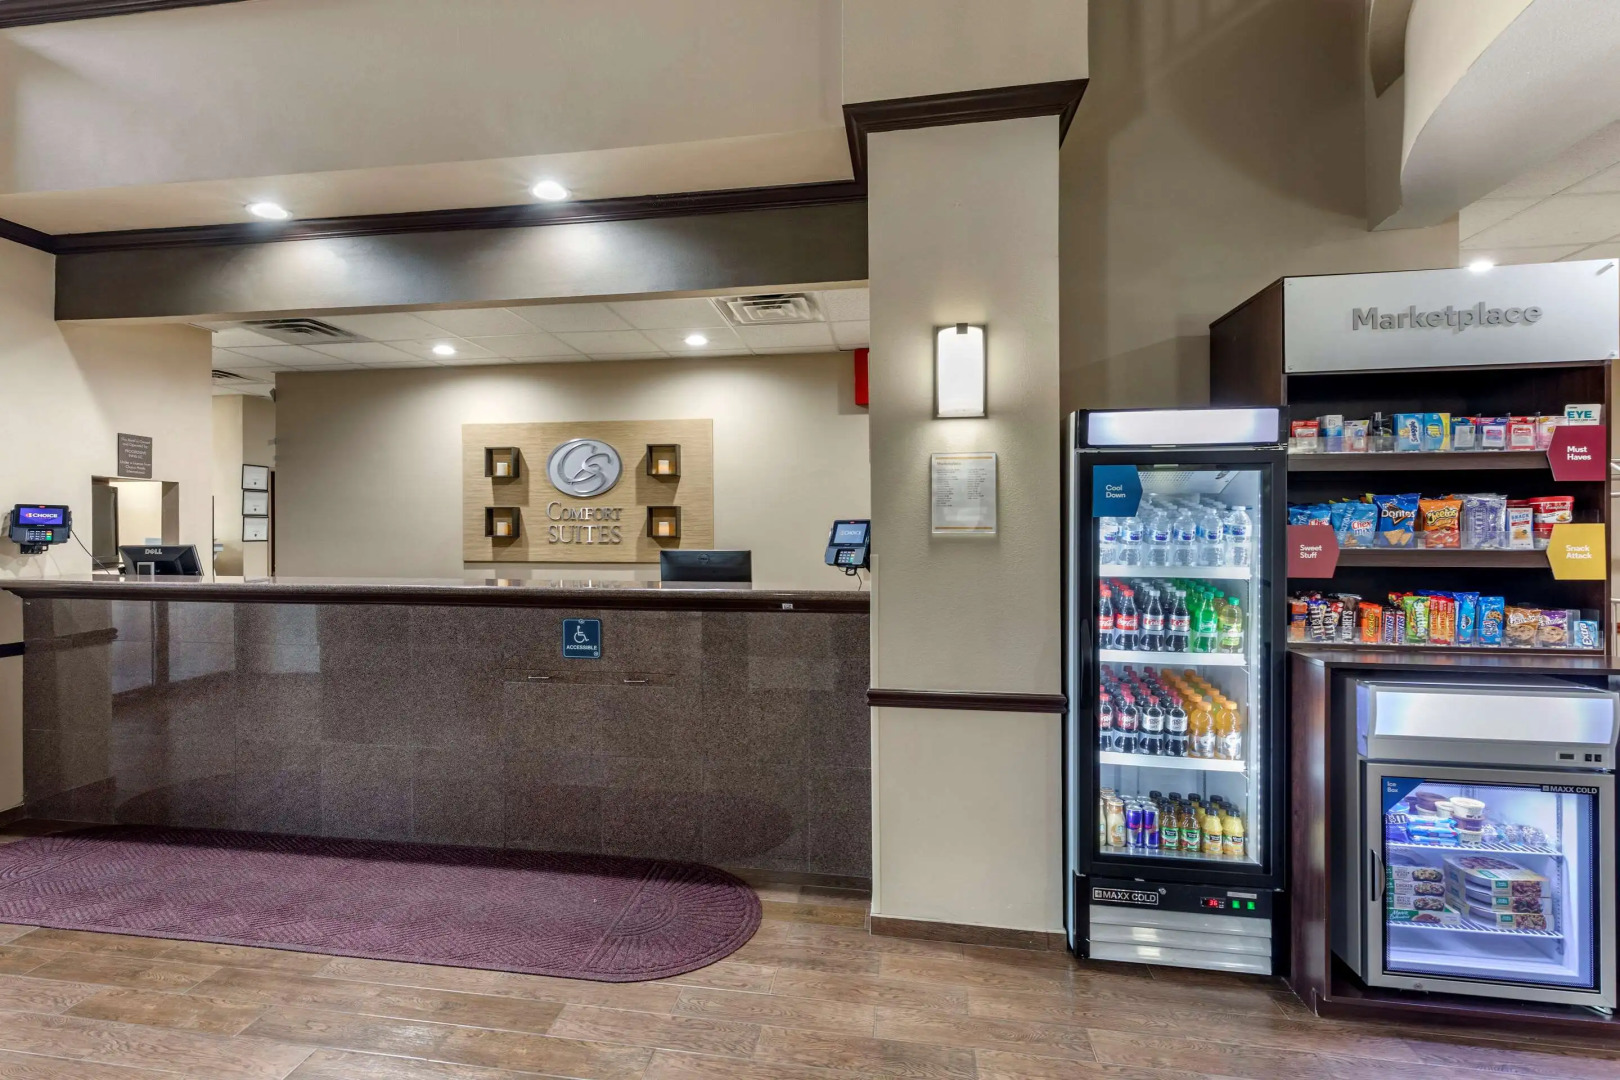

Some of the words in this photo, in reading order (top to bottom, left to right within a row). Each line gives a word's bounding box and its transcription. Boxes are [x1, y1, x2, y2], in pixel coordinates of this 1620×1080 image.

[1352, 301, 1544, 332] Marketplace
[1567, 410, 1592, 418] EYE
[1567, 445, 1587, 453] Must
[1567, 453, 1592, 461] Haves
[547, 501, 623, 521] COMFORT
[1381, 509, 1416, 518] Doritos
[1426, 507, 1458, 524] Cheetos
[1351, 520, 1372, 530] Chex
[548, 524, 623, 545] SUITES
[1565, 544, 1590, 552] Snack
[1300, 551, 1318, 559] Stuff
[1550, 785, 1575, 793] MAXX
[1576, 786, 1598, 794] COLD
[1102, 891, 1129, 900] MAXX
[1131, 893, 1157, 902] COLD
